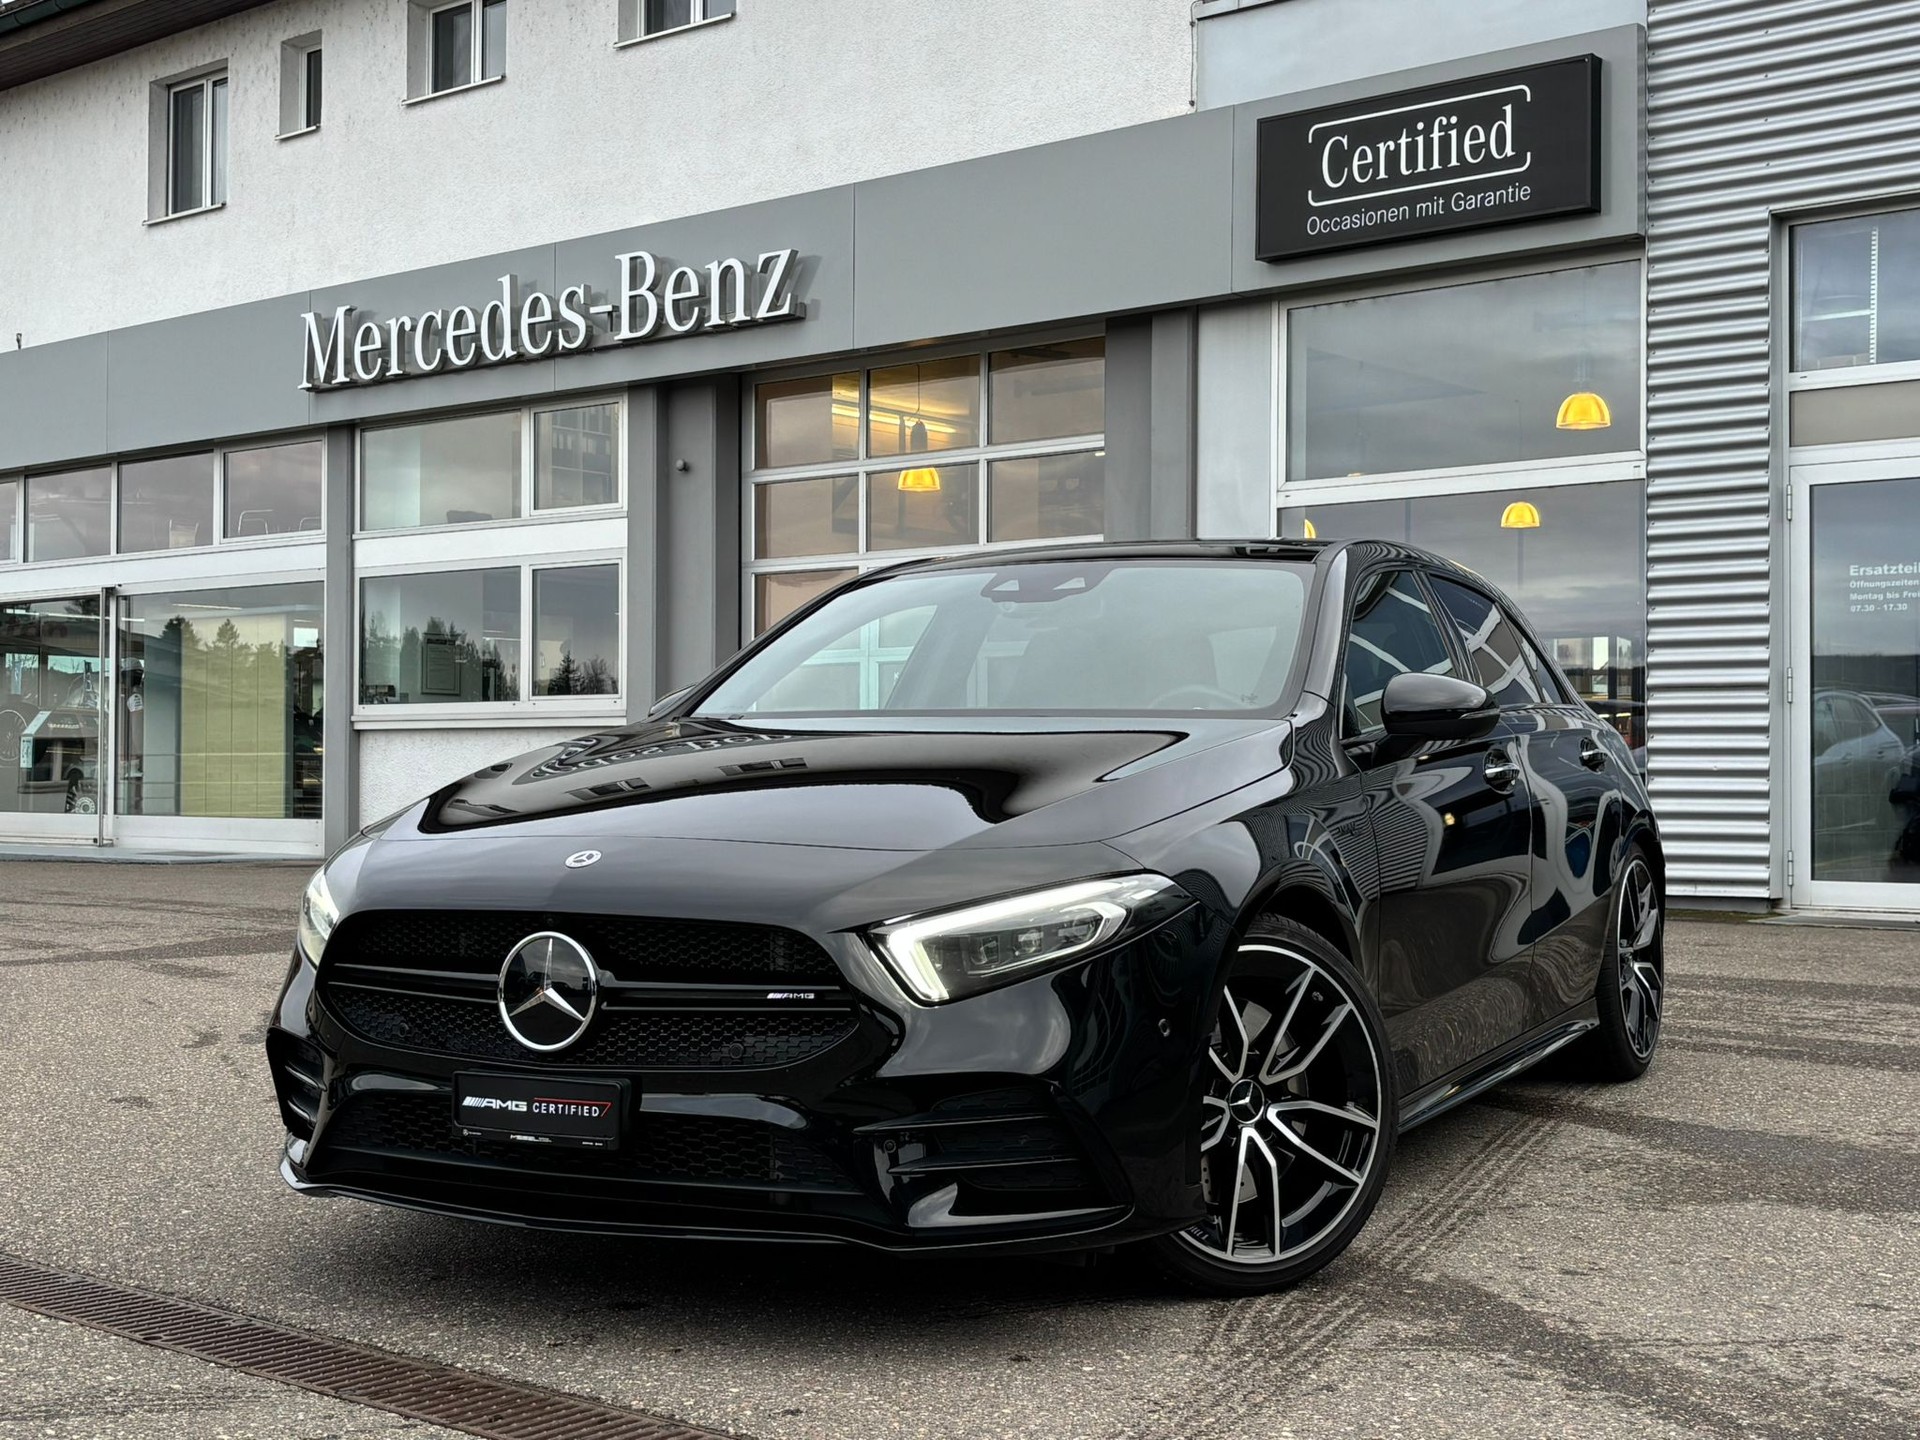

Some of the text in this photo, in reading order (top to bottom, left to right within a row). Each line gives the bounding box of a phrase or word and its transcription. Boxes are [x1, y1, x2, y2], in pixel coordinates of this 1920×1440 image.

[1321, 103, 1516, 188] Certified
[1306, 182, 1531, 235] Occasionen mit Garantie
[297, 248, 801, 391] Mercedes-Benz
[1850, 604, 1875, 612] 07.30
[1883, 603, 1908, 611] 17.30
[1886, 591, 1900, 599] bis
[480, 1097, 600, 1117] AMG CERTIFIED
